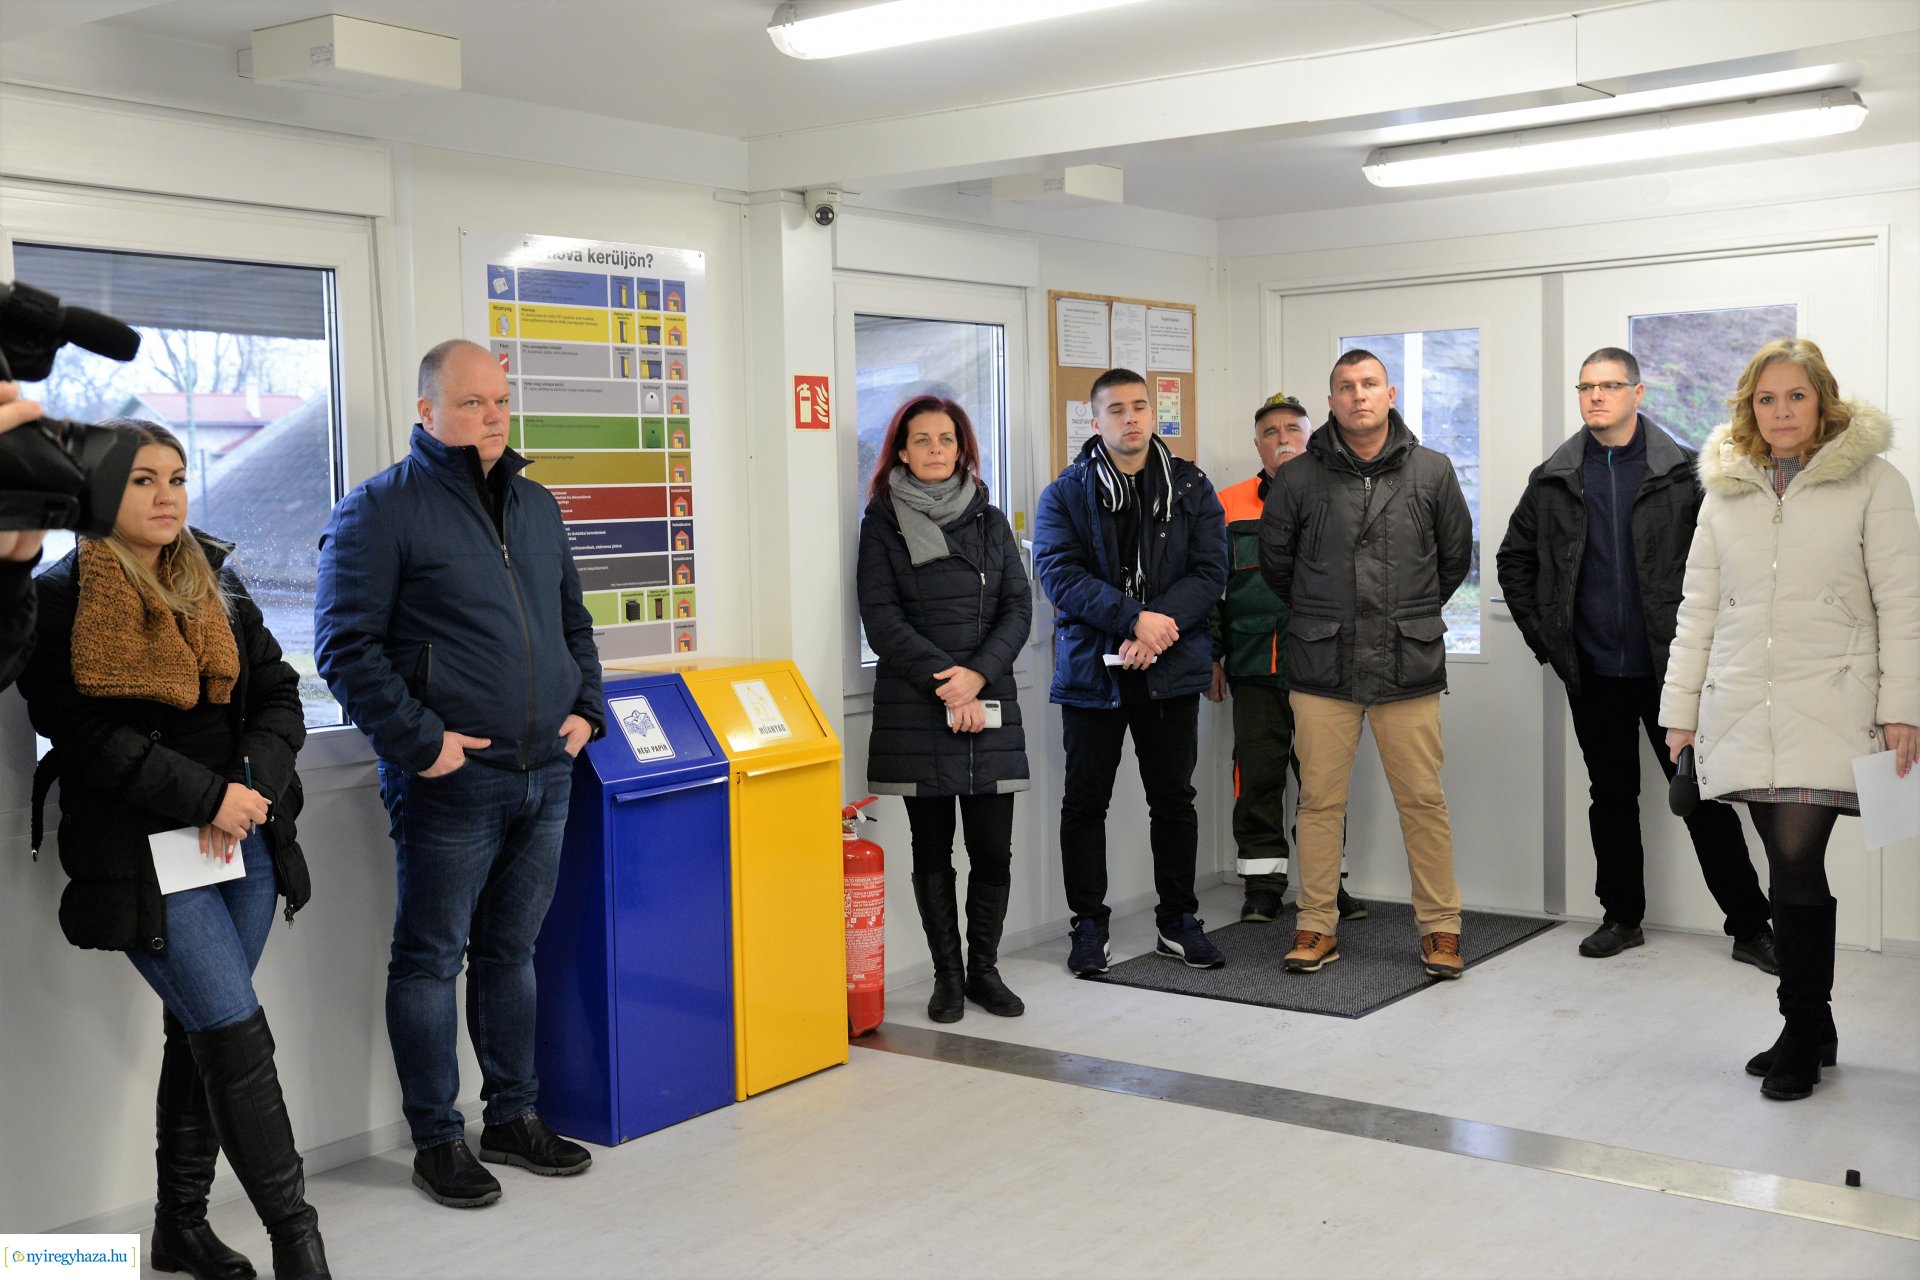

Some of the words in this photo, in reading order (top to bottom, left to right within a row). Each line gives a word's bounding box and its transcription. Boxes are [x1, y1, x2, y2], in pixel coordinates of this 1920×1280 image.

[587, 248, 654, 269] kerüljön?
[637, 746, 651, 755] RÉGI
[651, 744, 669, 753] PAPÍR
